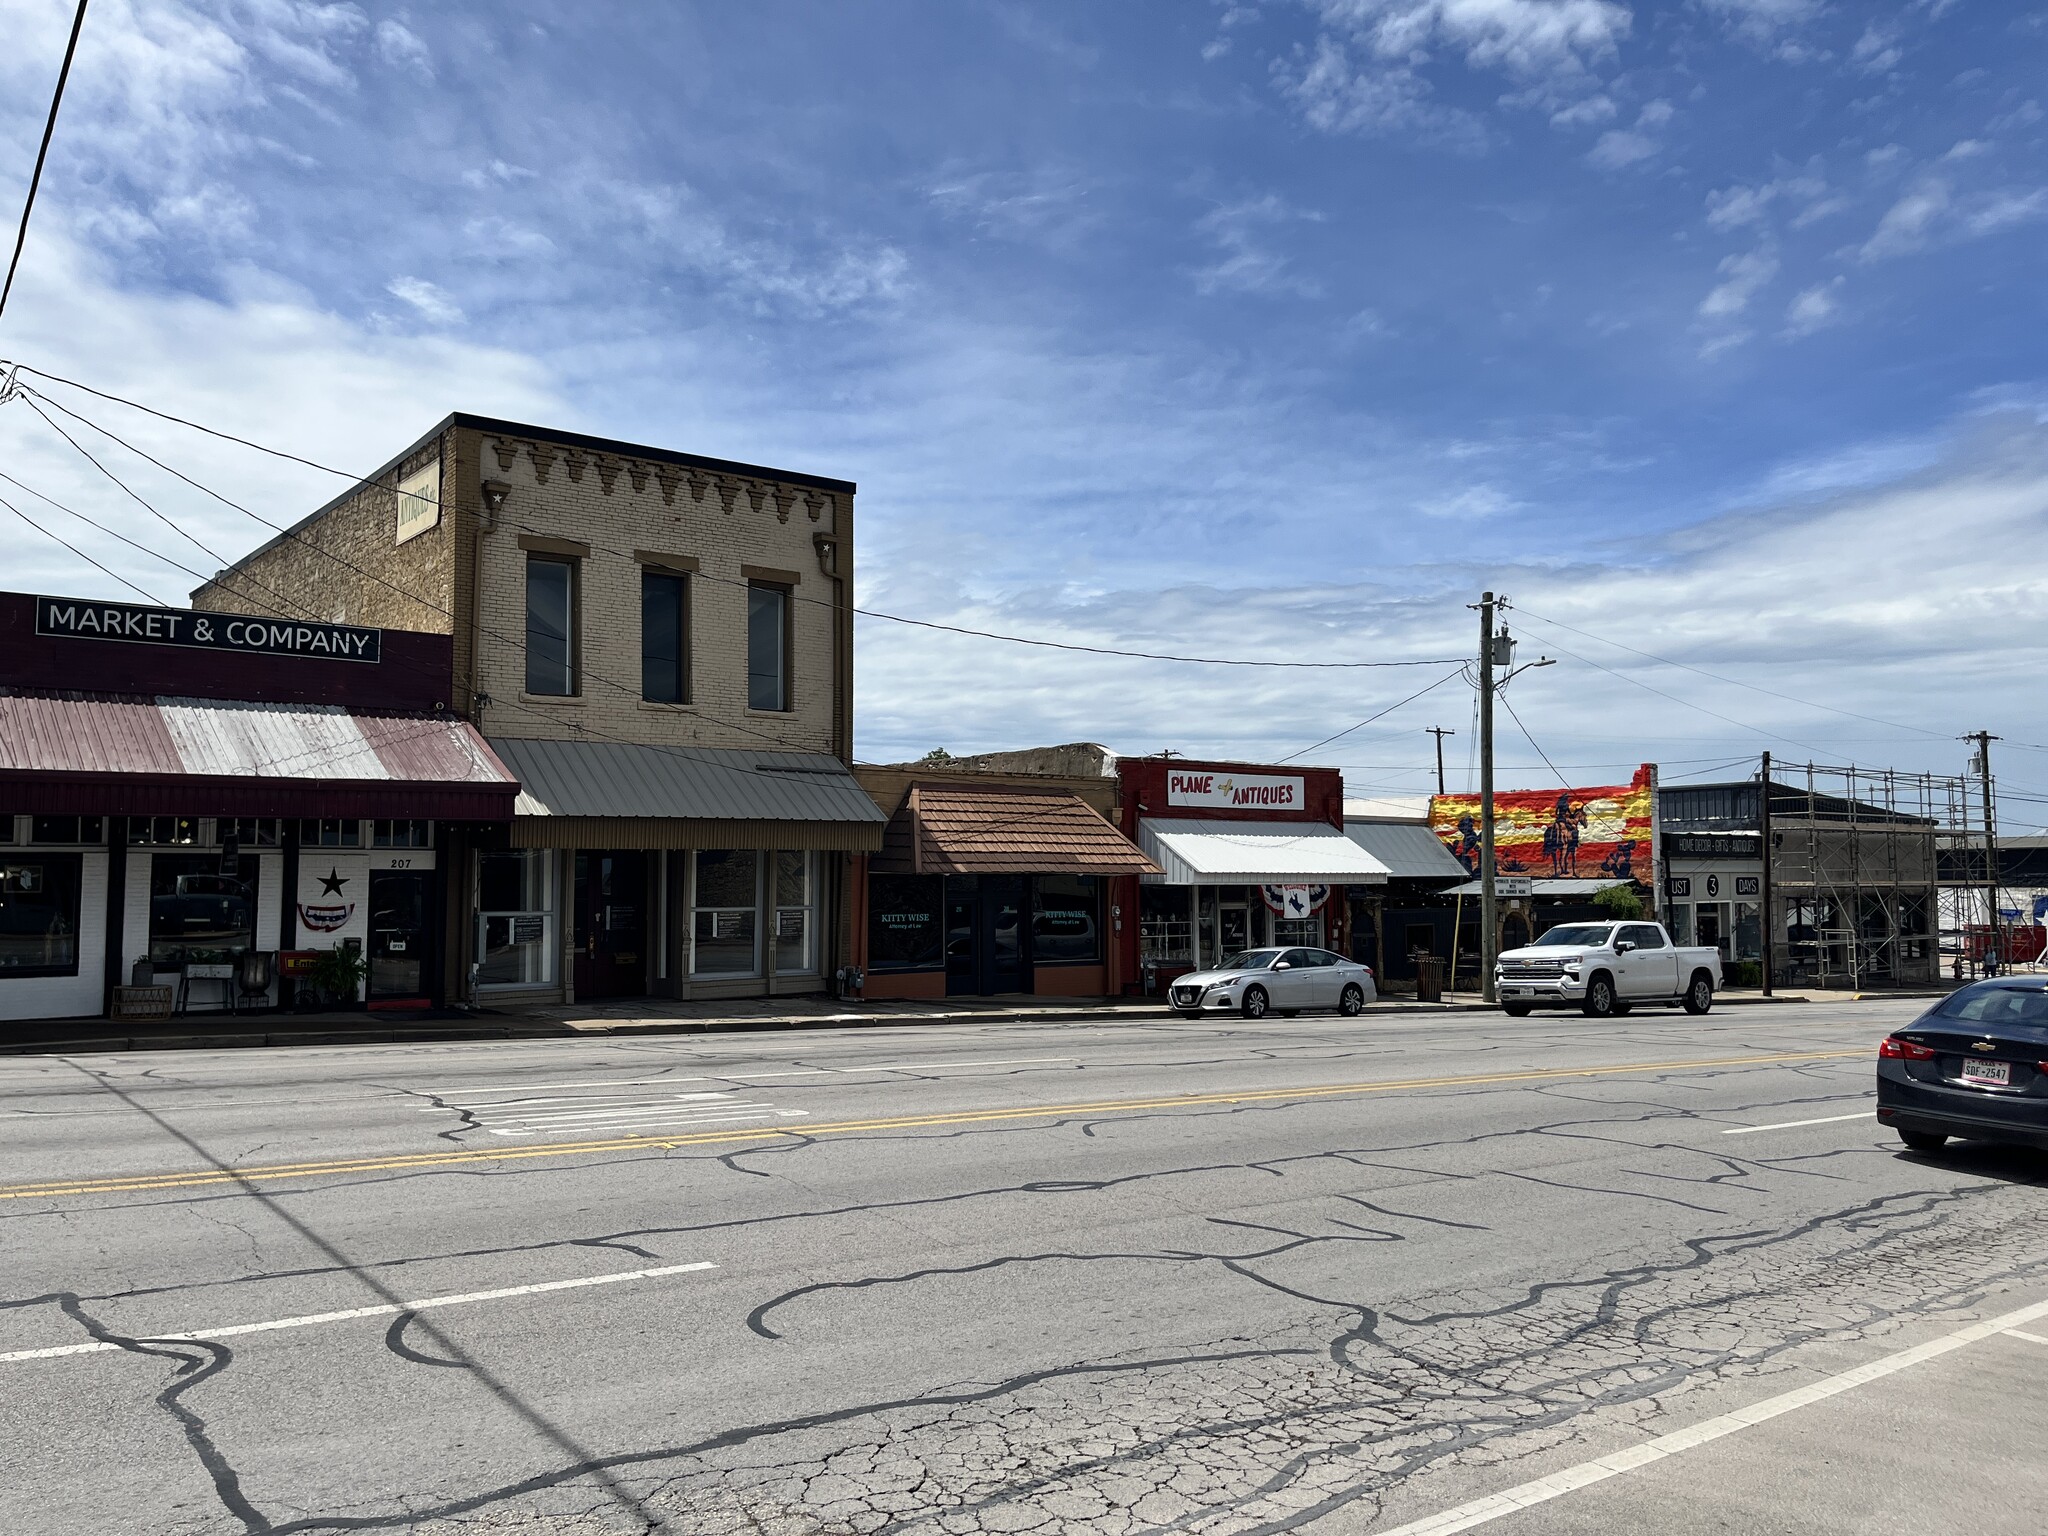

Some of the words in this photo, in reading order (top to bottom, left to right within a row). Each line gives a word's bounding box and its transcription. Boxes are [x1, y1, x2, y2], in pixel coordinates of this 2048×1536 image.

[49, 604, 182, 638] MARKET
[193, 618, 215, 642] &
[226, 621, 370, 655] COMPANY
[1171, 776, 1214, 794] PLANE
[1232, 784, 1293, 805] ANTIQUES
[1679, 838, 1694, 852] HOME
[1694, 838, 1712, 852] DECOR
[1714, 839, 1729, 852] GIFTS
[1731, 839, 1755, 853] ANTIQUES
[391, 859, 411, 868] 207
[1669, 880, 1688, 894] UST
[1709, 878, 1717, 894] 3
[1738, 879, 1757, 893] DAYS
[881, 913, 906, 922] KITTY
[908, 913, 930, 922] WISE
[1045, 911, 1066, 919] KITTY
[1067, 910, 1087, 918] WISE
